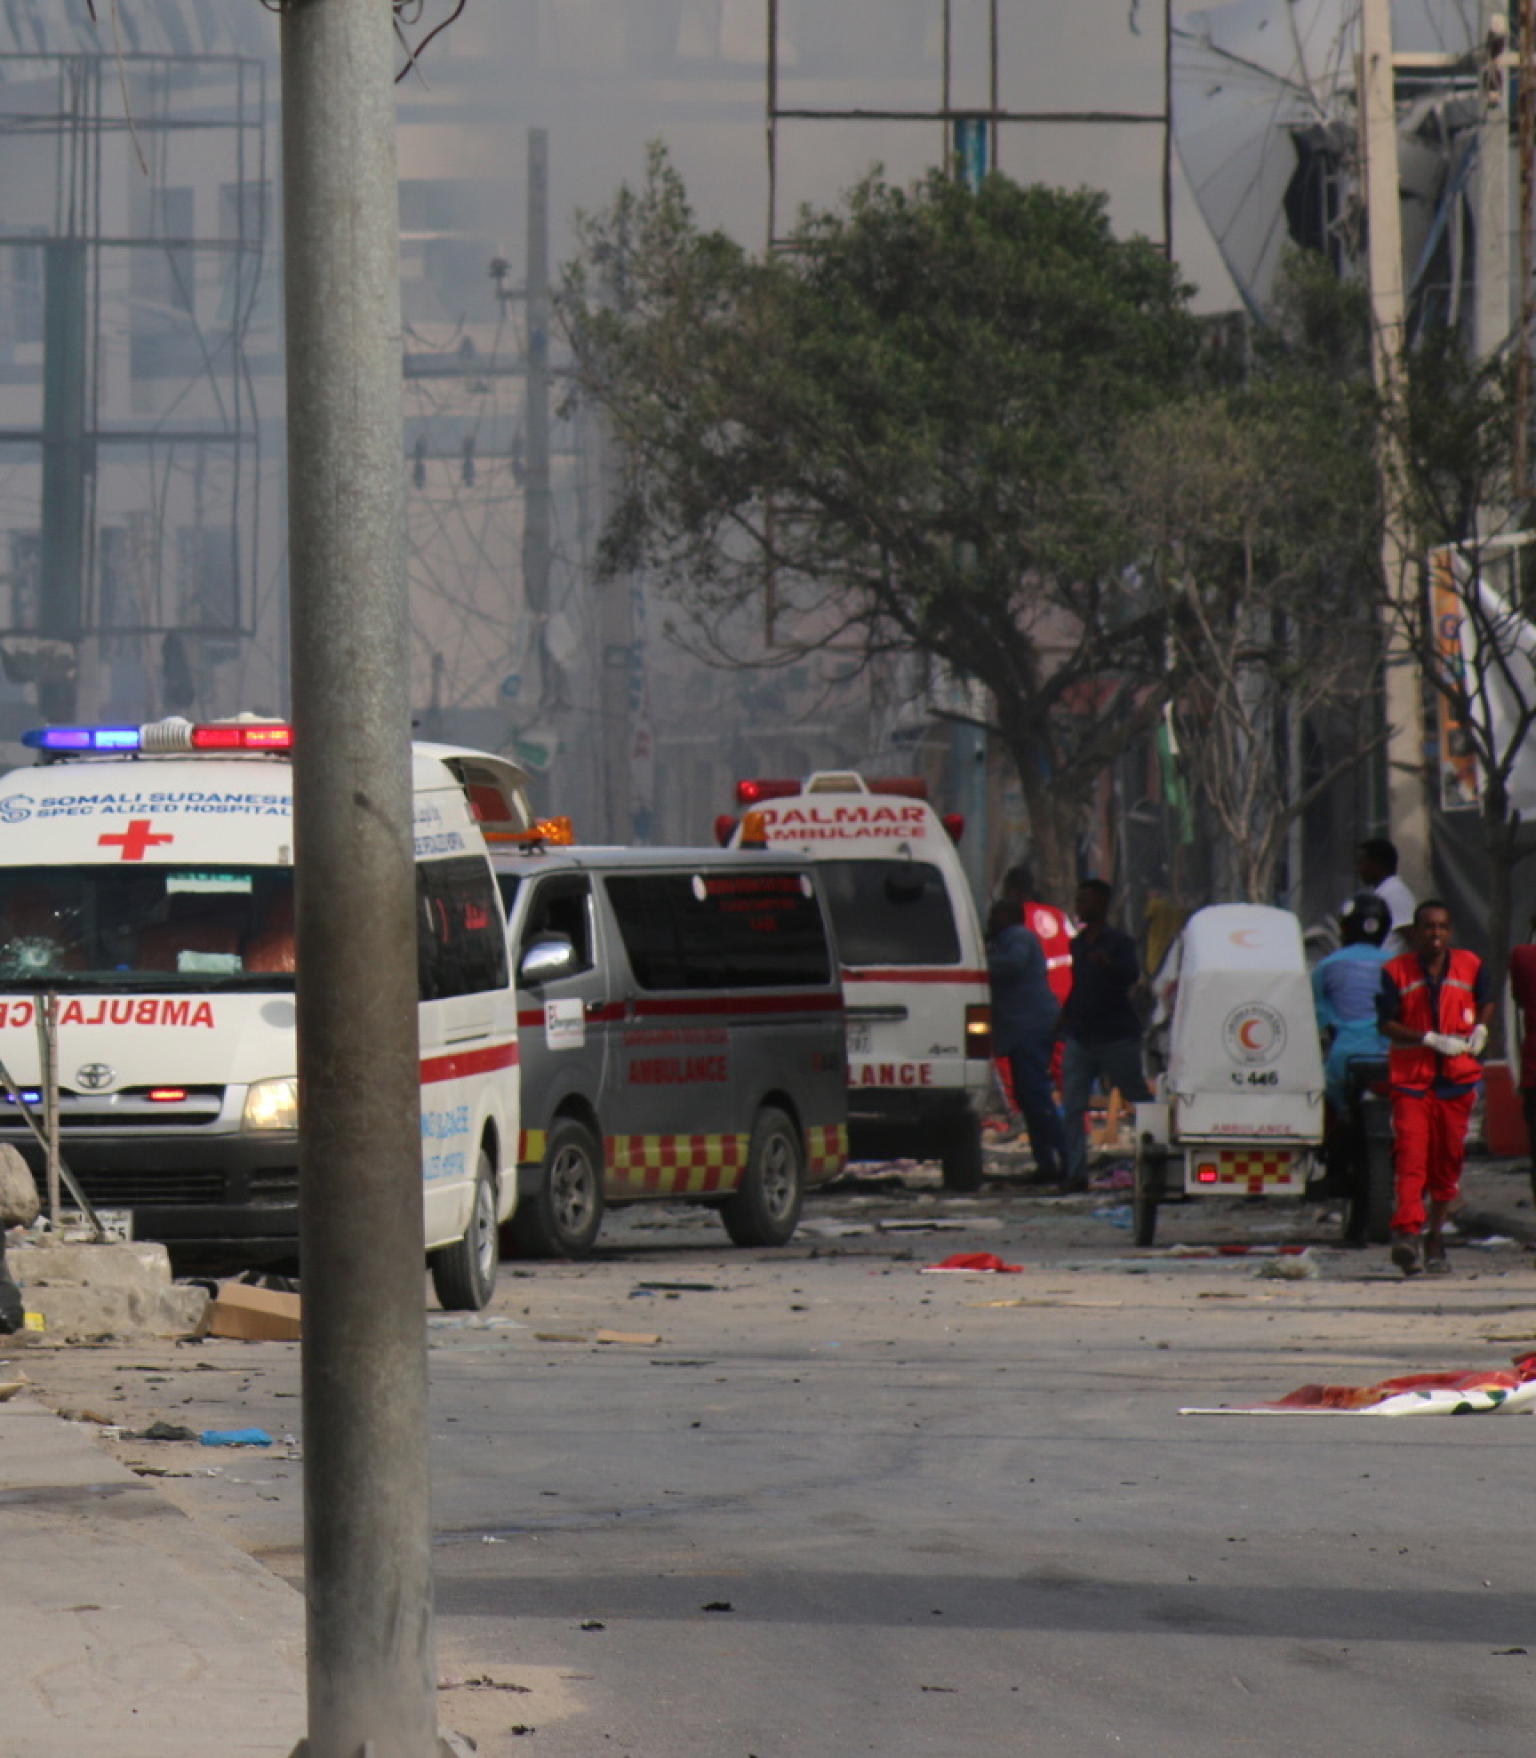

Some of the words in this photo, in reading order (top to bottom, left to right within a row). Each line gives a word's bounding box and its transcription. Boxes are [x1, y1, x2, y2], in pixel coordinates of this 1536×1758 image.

[41, 792, 142, 807] SOMALI
[150, 792, 293, 805] SUDANESE
[185, 804, 291, 816] HOSPITAL
[764, 825, 927, 842] MBULANCE
[627, 1055, 731, 1085] AMBULANCE
